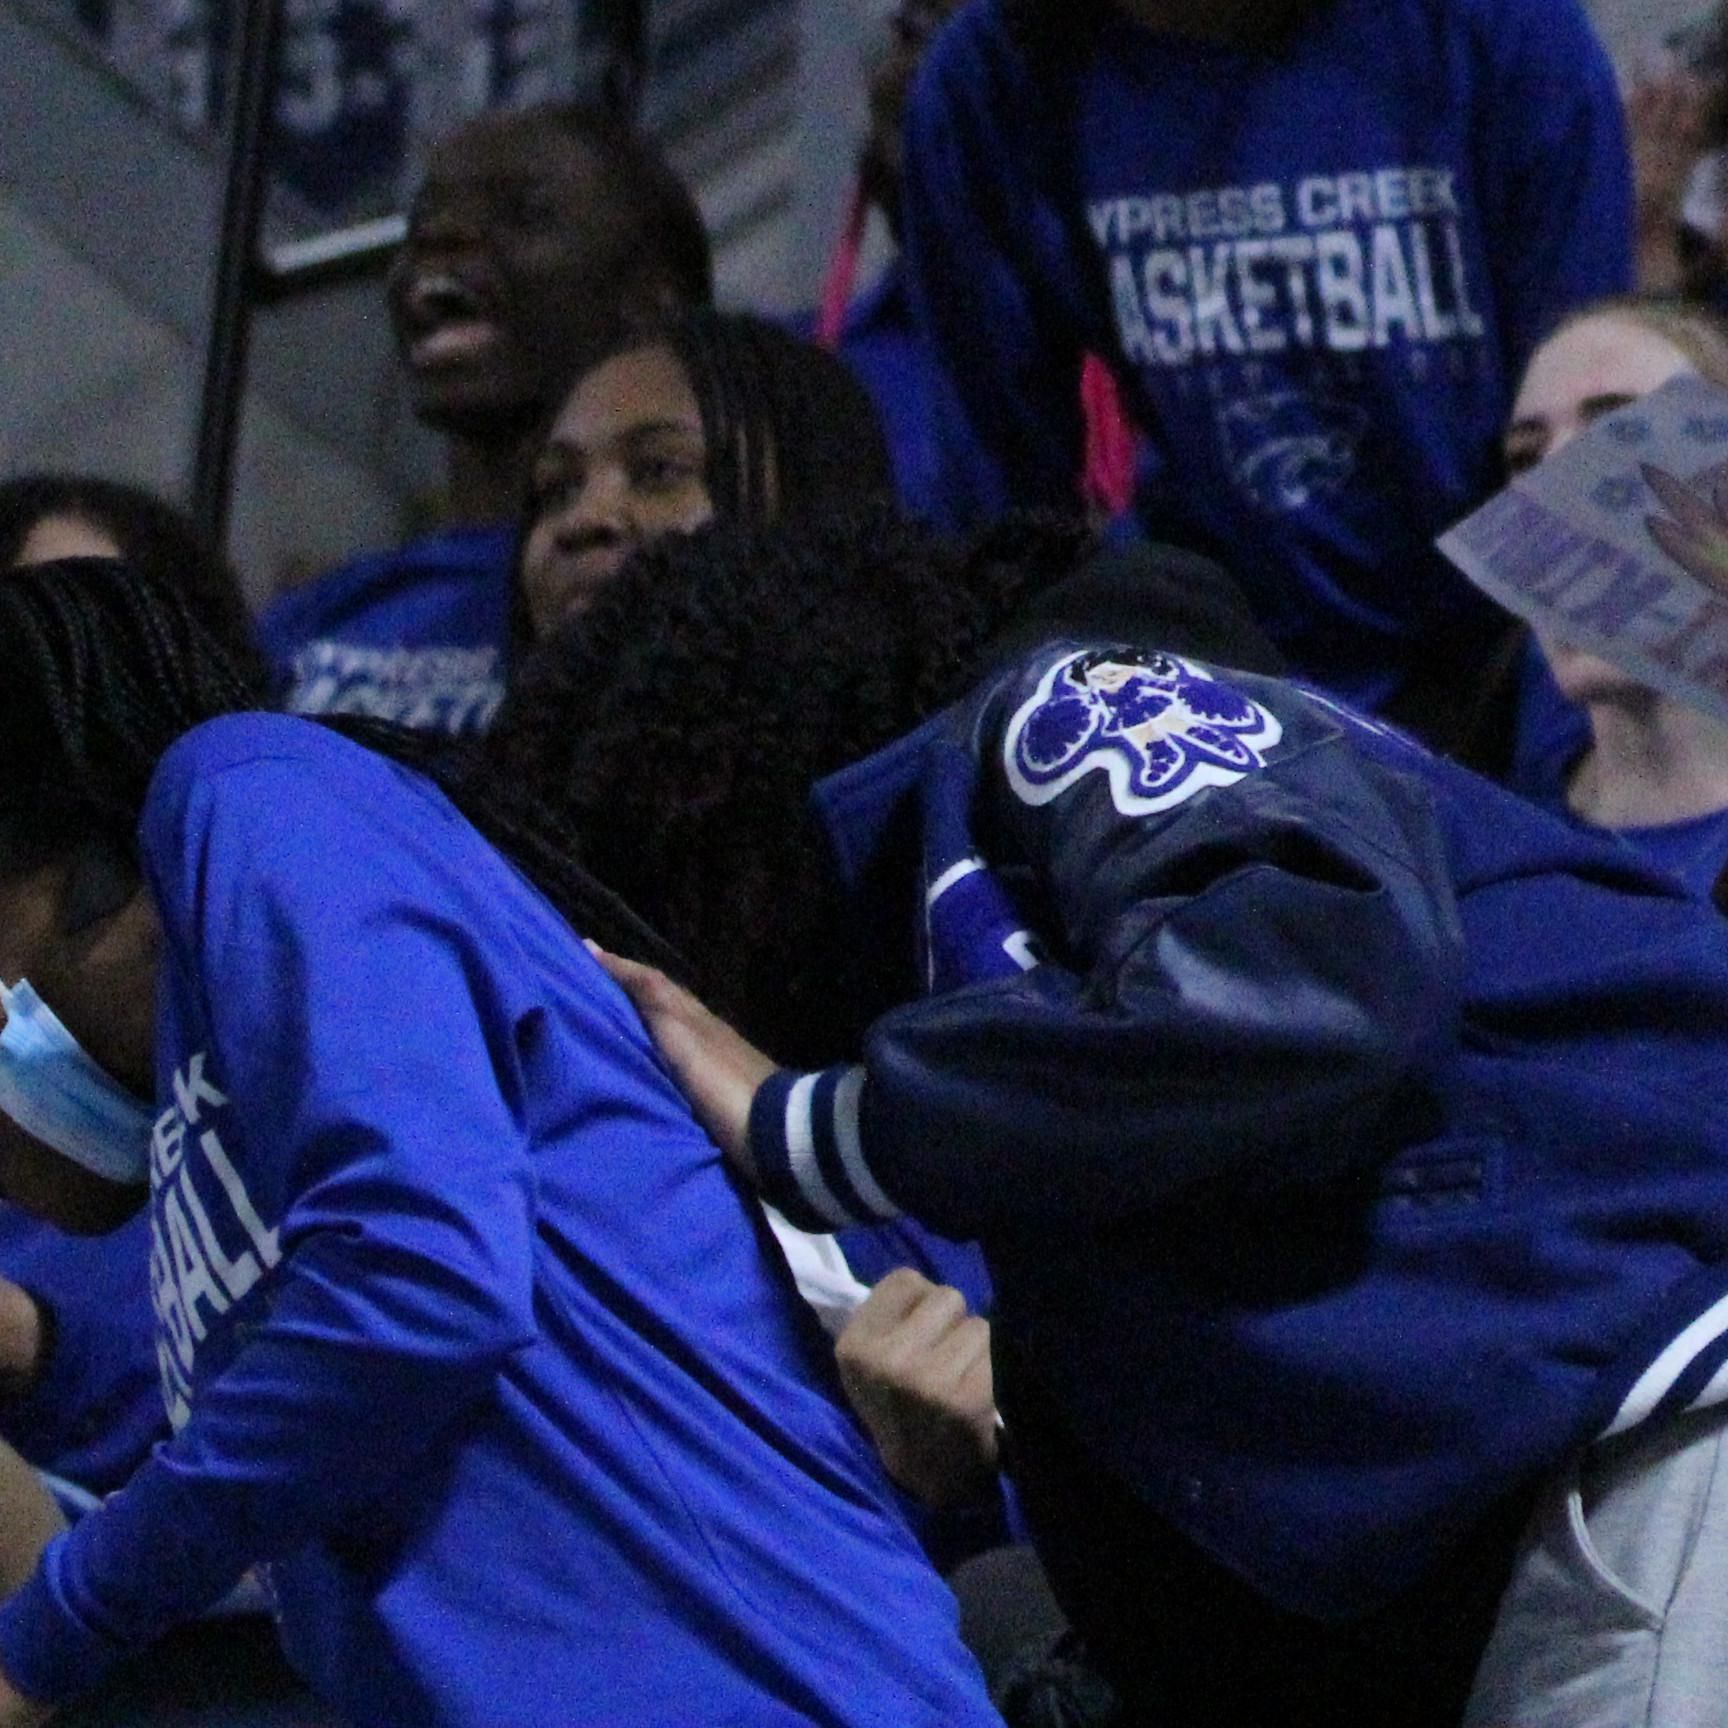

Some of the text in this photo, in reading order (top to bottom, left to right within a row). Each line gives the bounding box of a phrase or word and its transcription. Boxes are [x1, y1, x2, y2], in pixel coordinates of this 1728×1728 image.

[1086, 167, 1463, 249] YPRESS CREEK
[1108, 220, 1485, 368] ASKETBALL
